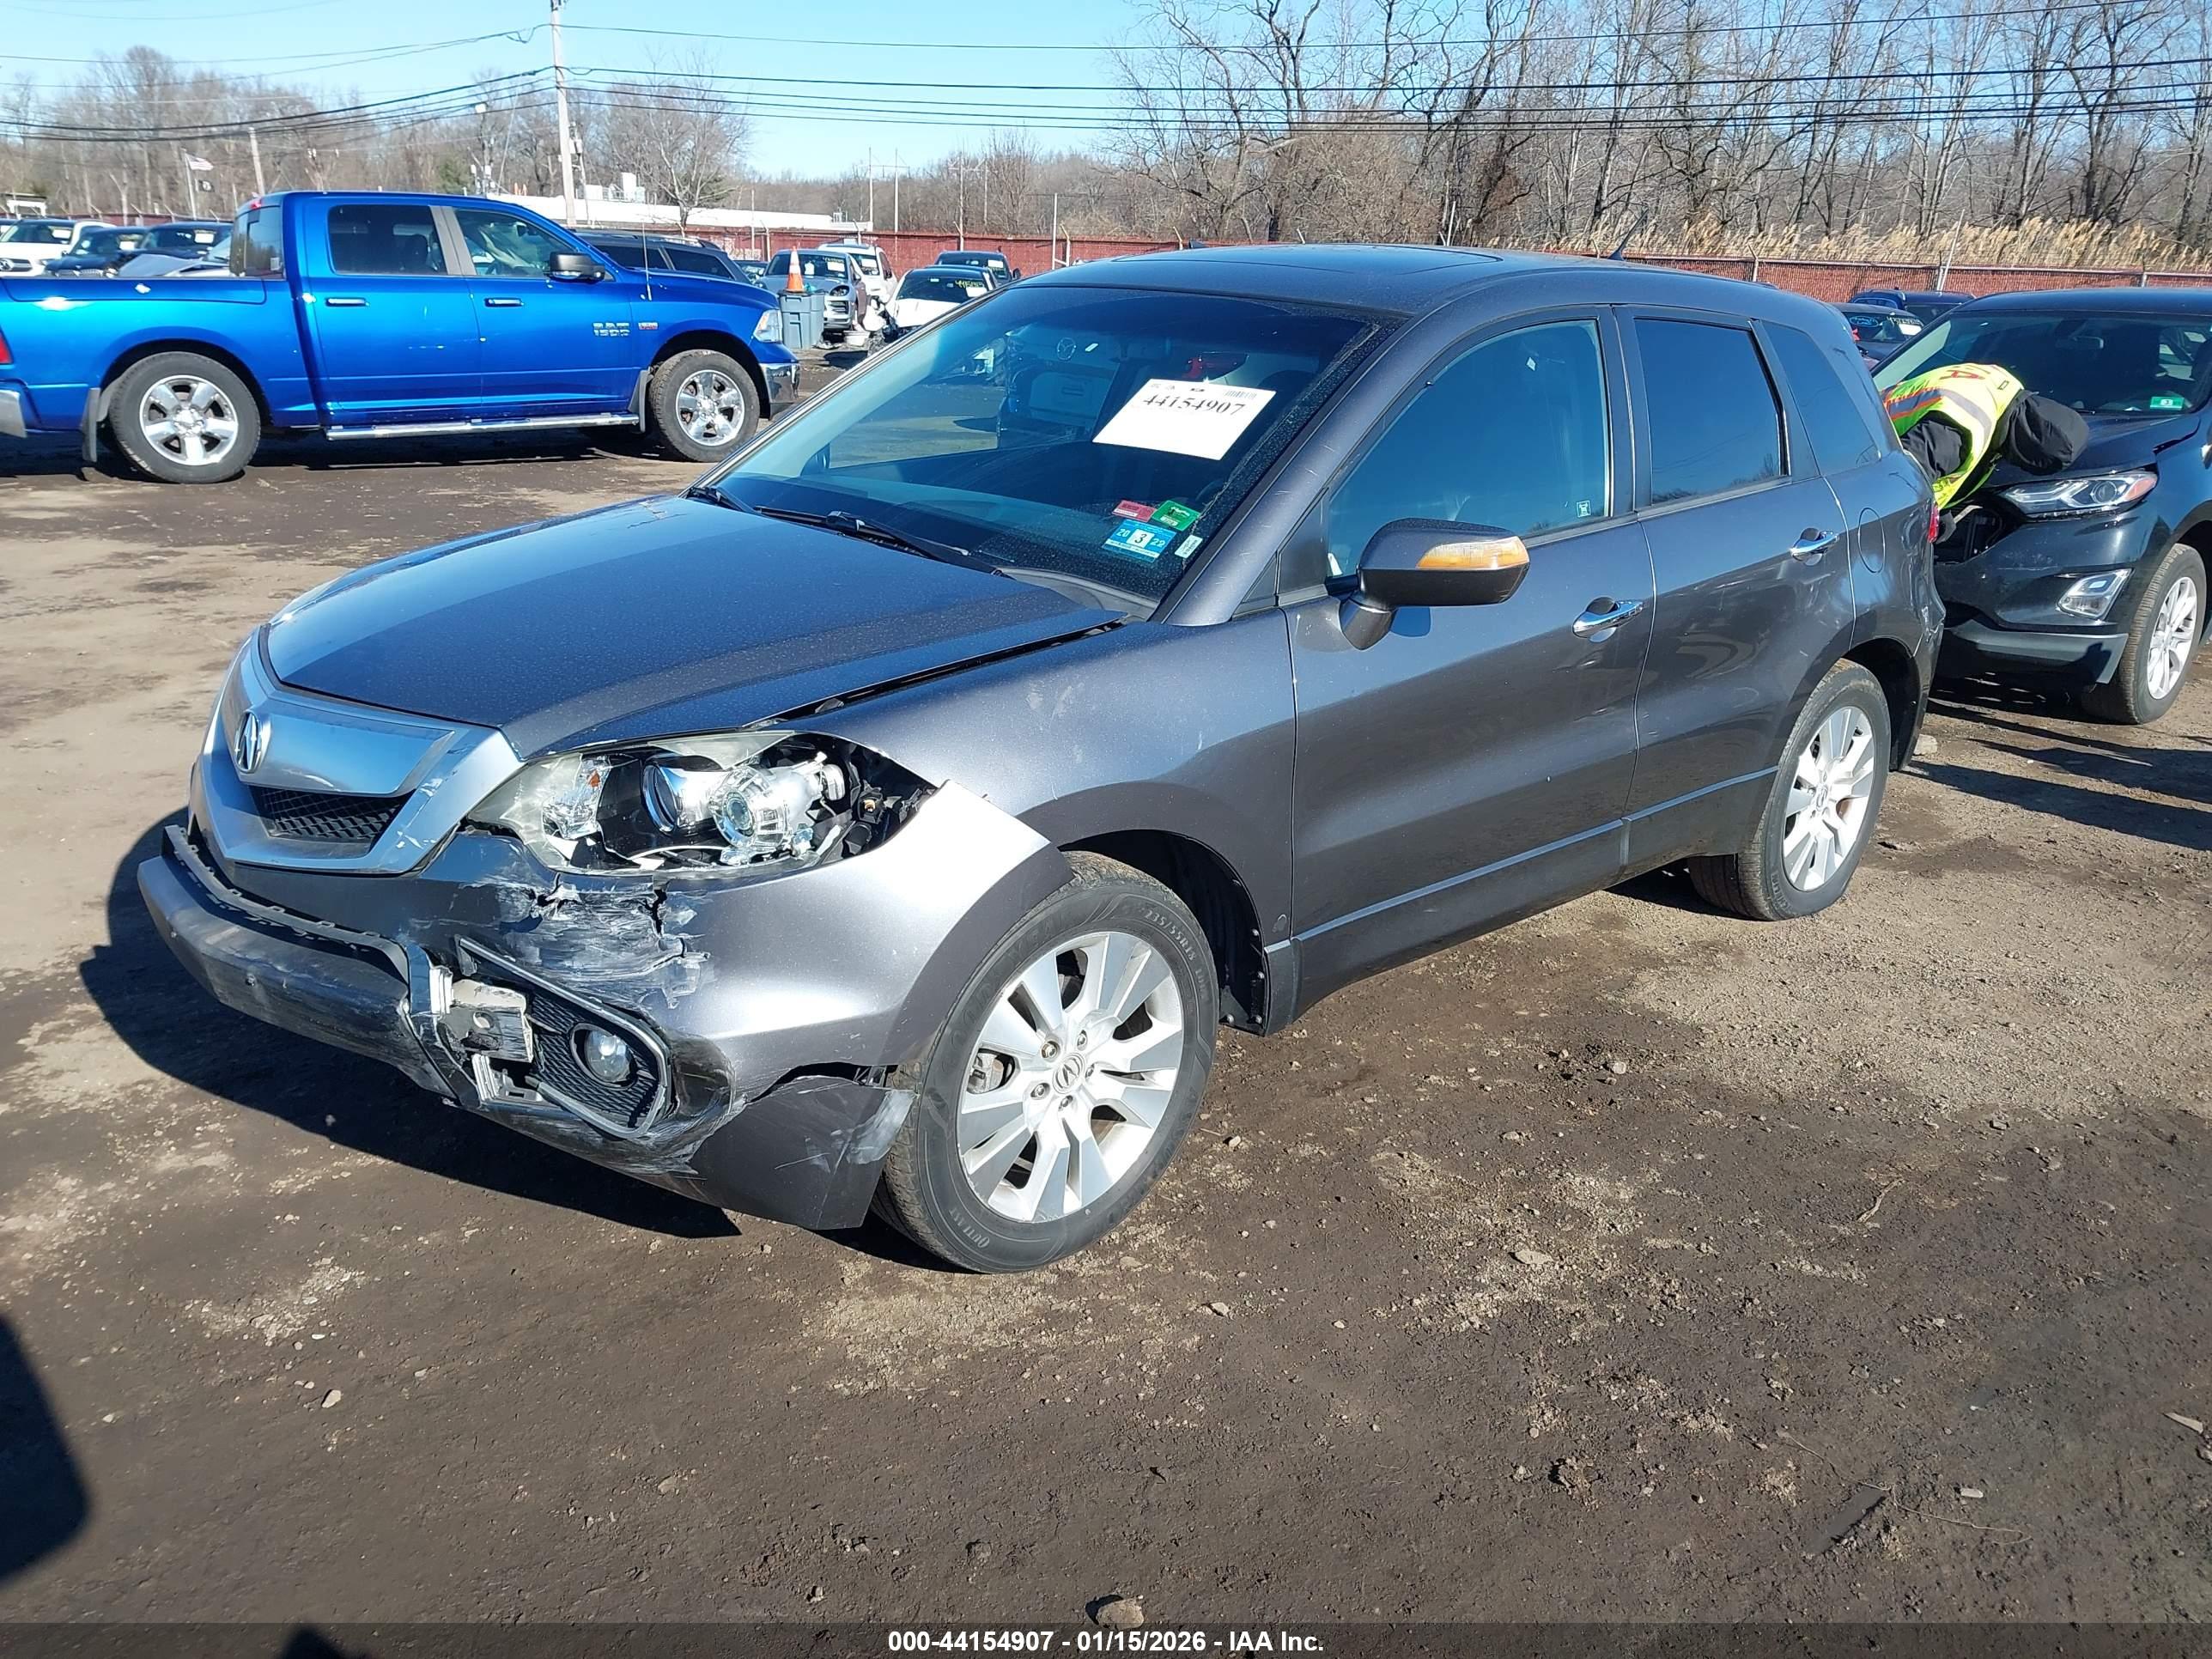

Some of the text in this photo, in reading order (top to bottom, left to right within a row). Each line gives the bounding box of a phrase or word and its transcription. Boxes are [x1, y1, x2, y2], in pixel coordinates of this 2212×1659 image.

[1143, 394, 1246, 415] 44154907
[1116, 528, 1131, 538] 20
[1134, 533, 1147, 544] 3
[1150, 538, 1165, 548] 22
[1143, 908, 1197, 963] 235/55R18
[948, 1207, 990, 1249] OUTLAST
